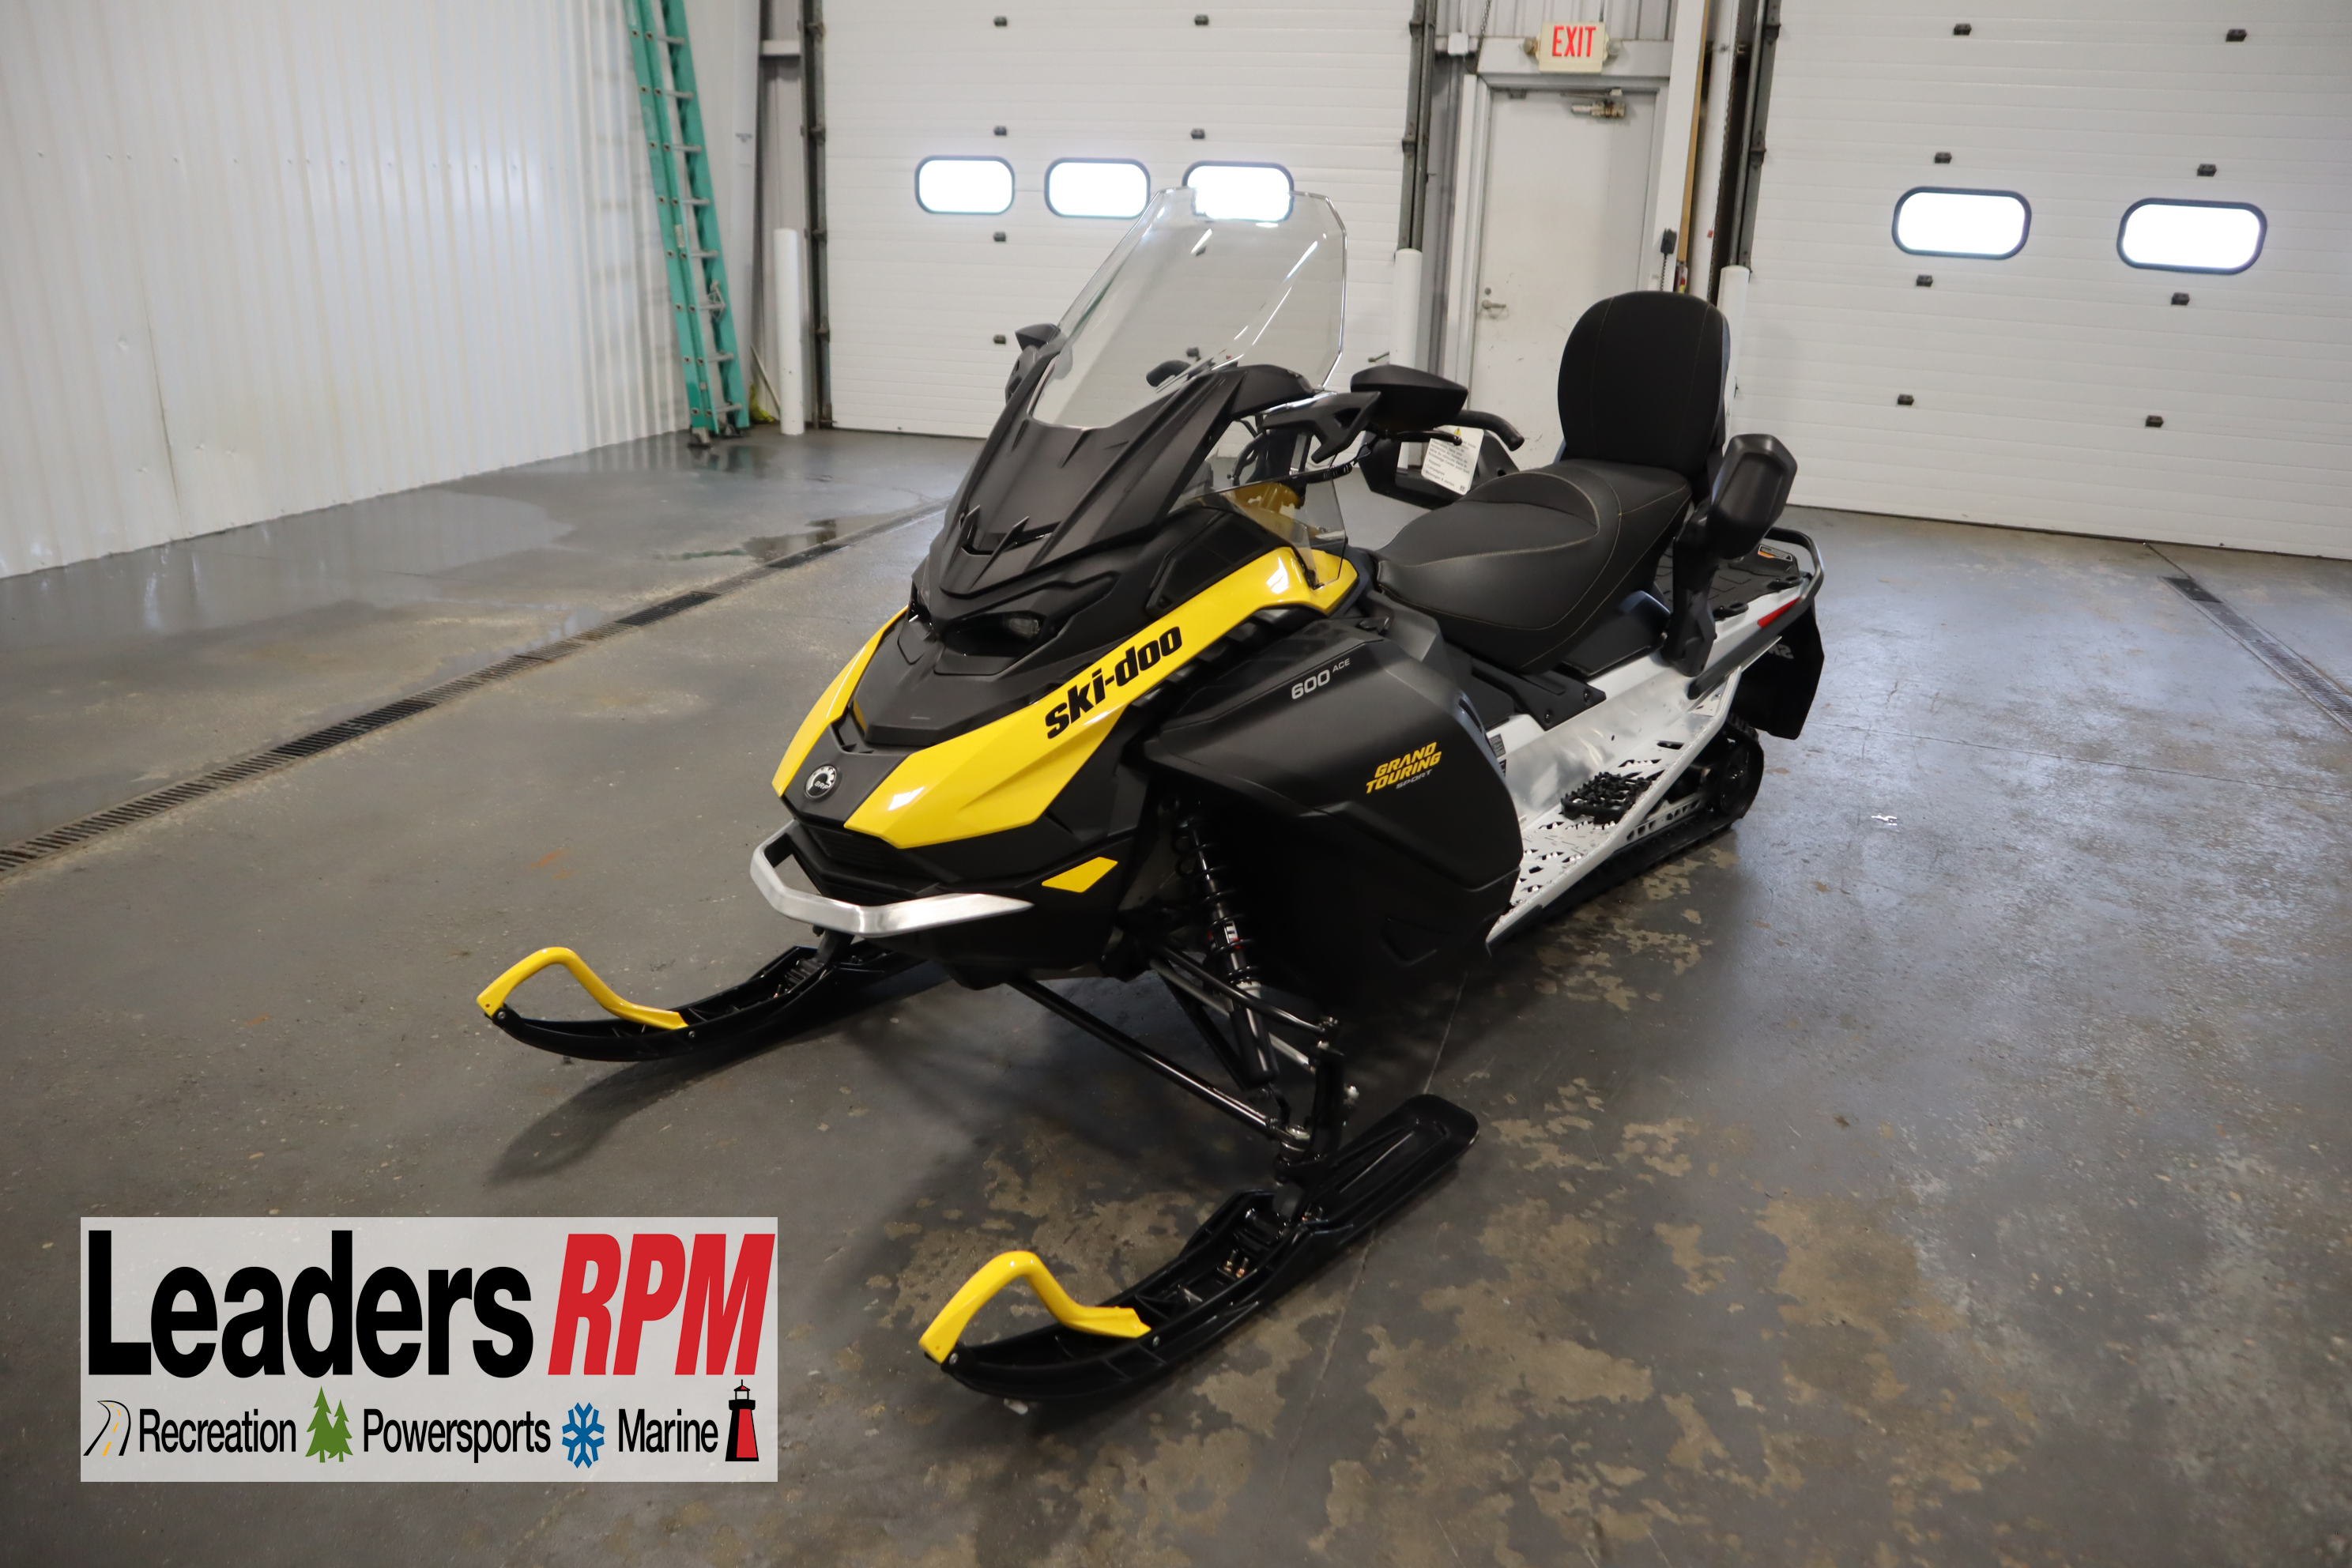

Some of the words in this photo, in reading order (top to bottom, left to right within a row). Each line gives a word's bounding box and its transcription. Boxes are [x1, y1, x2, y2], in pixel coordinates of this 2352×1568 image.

[1552, 24, 1596, 57] EXIT
[1045, 626, 1182, 739] ski-doo
[1291, 669, 1331, 700] 600
[1332, 658, 1351, 673] ACE
[1366, 751, 1442, 793] TOURING
[1374, 741, 1438, 778] GRAND
[814, 780, 830, 790] BRP
[1395, 768, 1433, 790] SPORT
